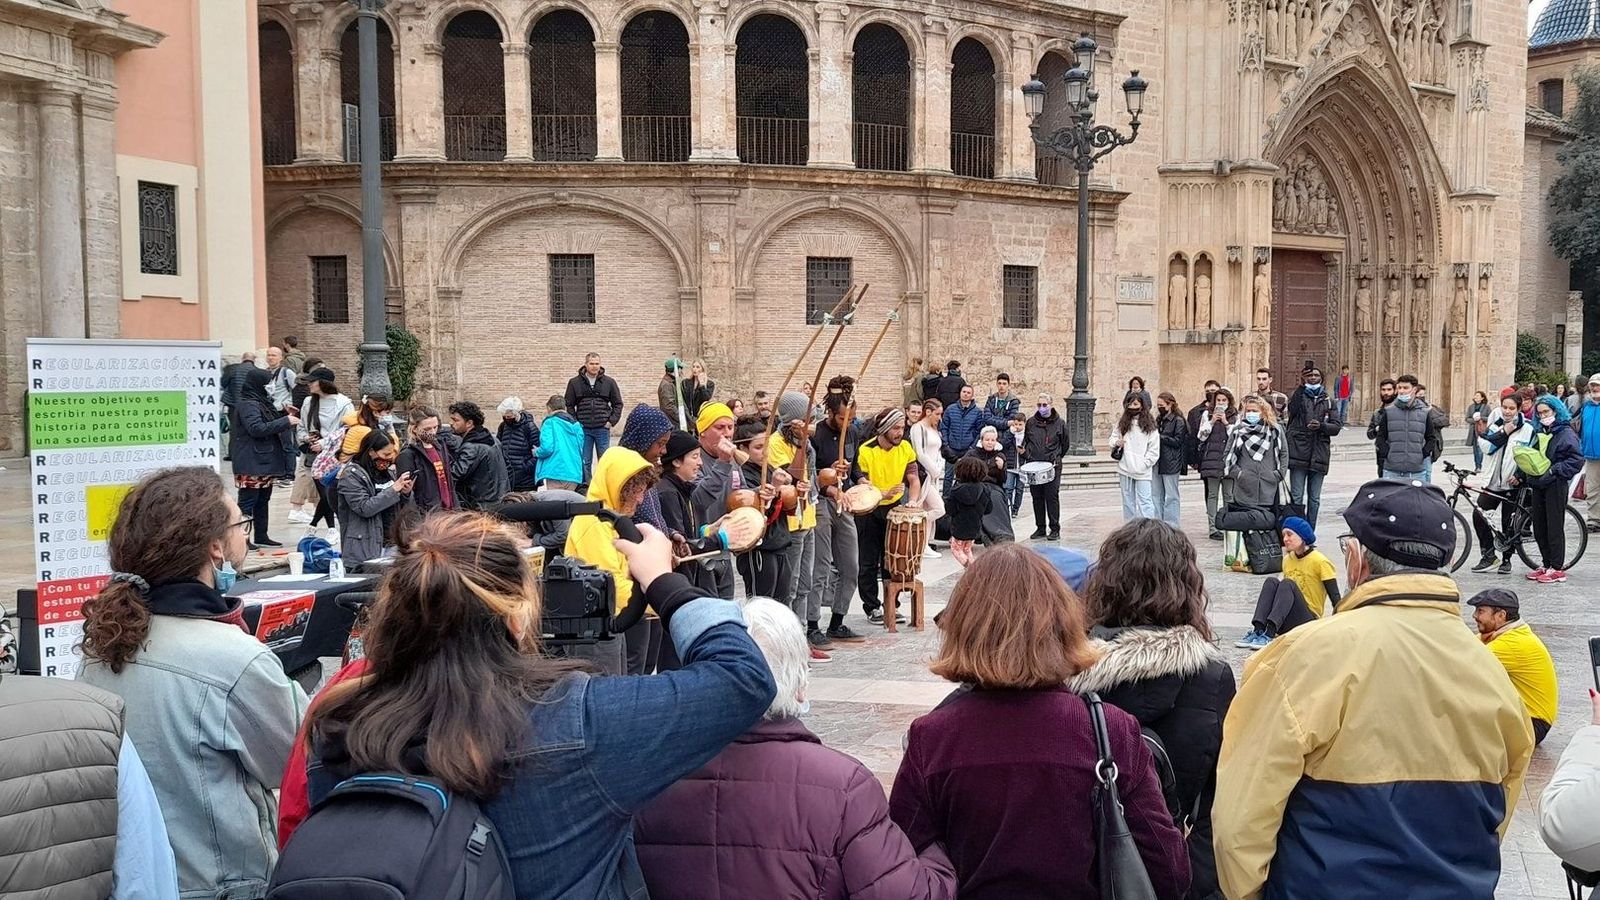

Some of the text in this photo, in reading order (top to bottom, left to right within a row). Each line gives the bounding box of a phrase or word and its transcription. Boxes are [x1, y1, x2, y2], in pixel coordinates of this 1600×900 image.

[34, 395, 160, 406] Nuestro objetivo es
[34, 407, 180, 419] escribir nuestra propia
[35, 419, 178, 432] historia para construir
[35, 431, 185, 445] una sociedad más justa
[43, 579, 109, 596] ¡Con tu fi
[44, 610, 83, 620] de co
